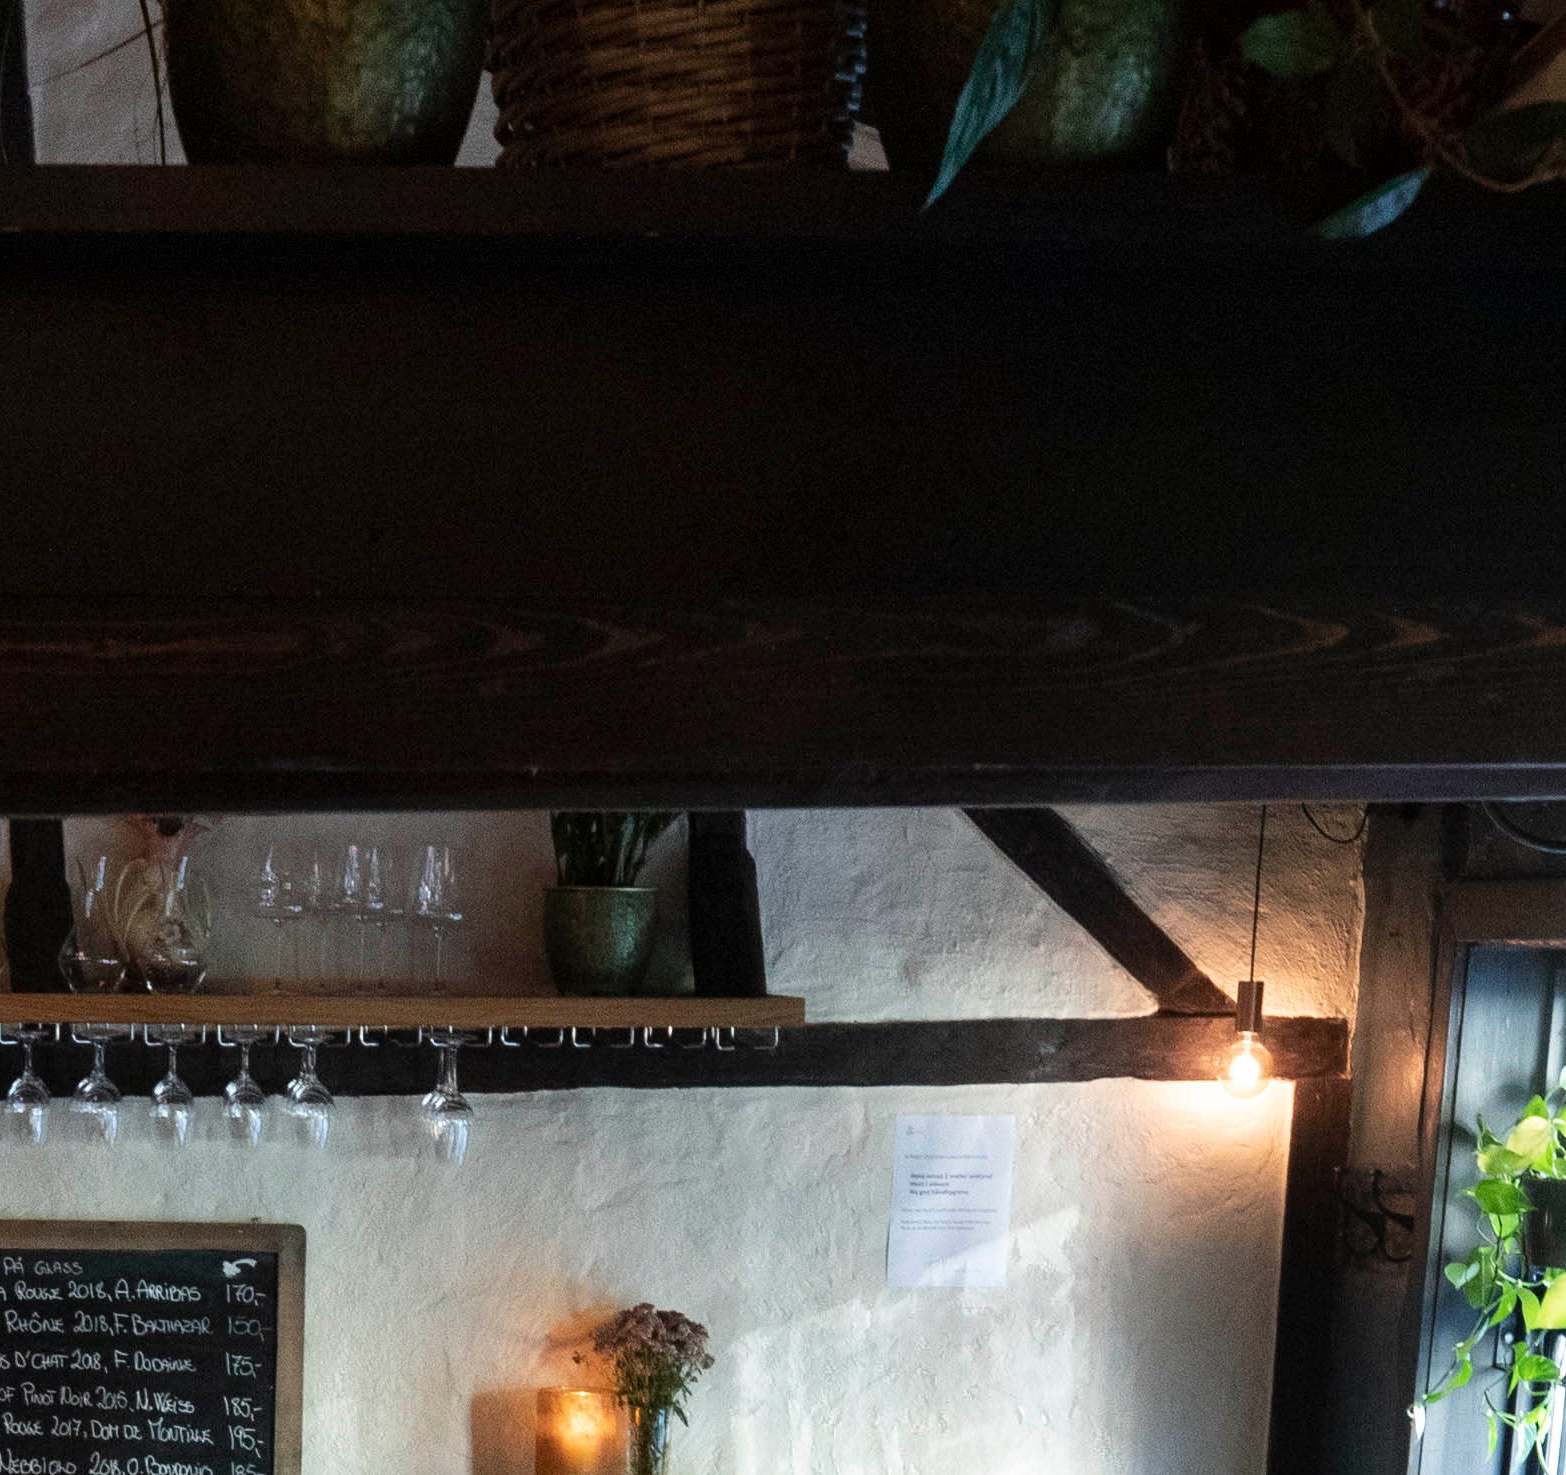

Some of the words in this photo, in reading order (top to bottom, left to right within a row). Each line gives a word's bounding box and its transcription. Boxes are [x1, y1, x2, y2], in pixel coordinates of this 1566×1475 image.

[4, 1256, 25, 1276] PÅ
[34, 1260, 84, 1276] GLASS
[15, 1280, 63, 1301] ROUGE
[68, 1281, 112, 1302] 2018,
[226, 1284, 266, 1306] 170,-
[5, 1310, 64, 1334] RHÔNE
[225, 1352, 263, 1378] 175,-
[20, 1381, 57, 1407] PINOT
[60, 1386, 93, 1407] NOIR
[223, 1396, 263, 1422] 185,-
[50, 1416, 88, 1438] 2017,
